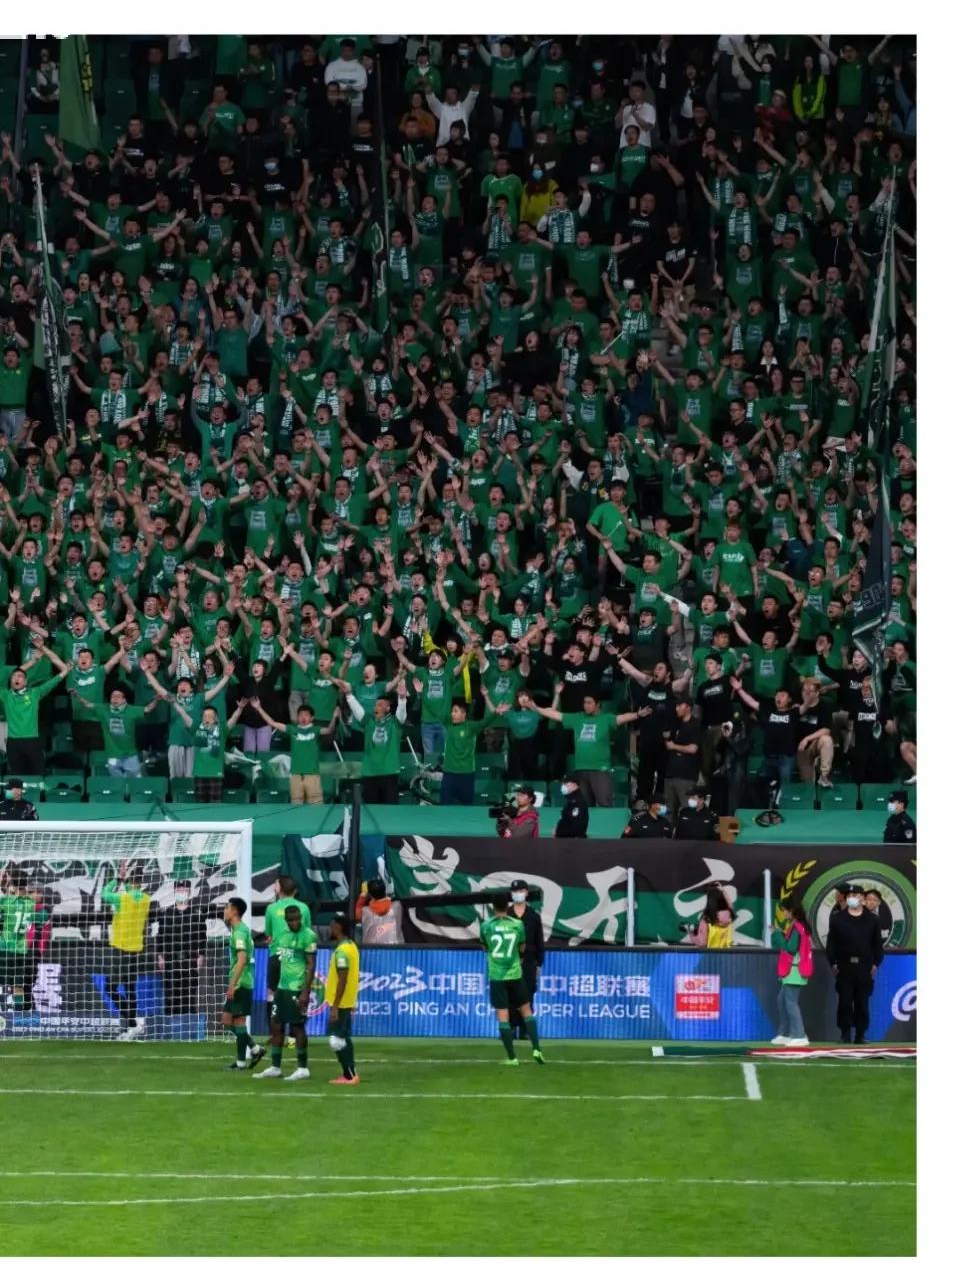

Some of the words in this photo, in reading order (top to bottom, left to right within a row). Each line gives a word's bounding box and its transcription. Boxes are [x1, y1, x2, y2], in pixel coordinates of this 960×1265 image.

[13, 911, 32, 934] 15
[490, 933, 517, 959] 27
[397, 1001, 439, 1016] PING
[443, 1002, 470, 1016] AN
[578, 1003, 651, 1019] LEAGUE
